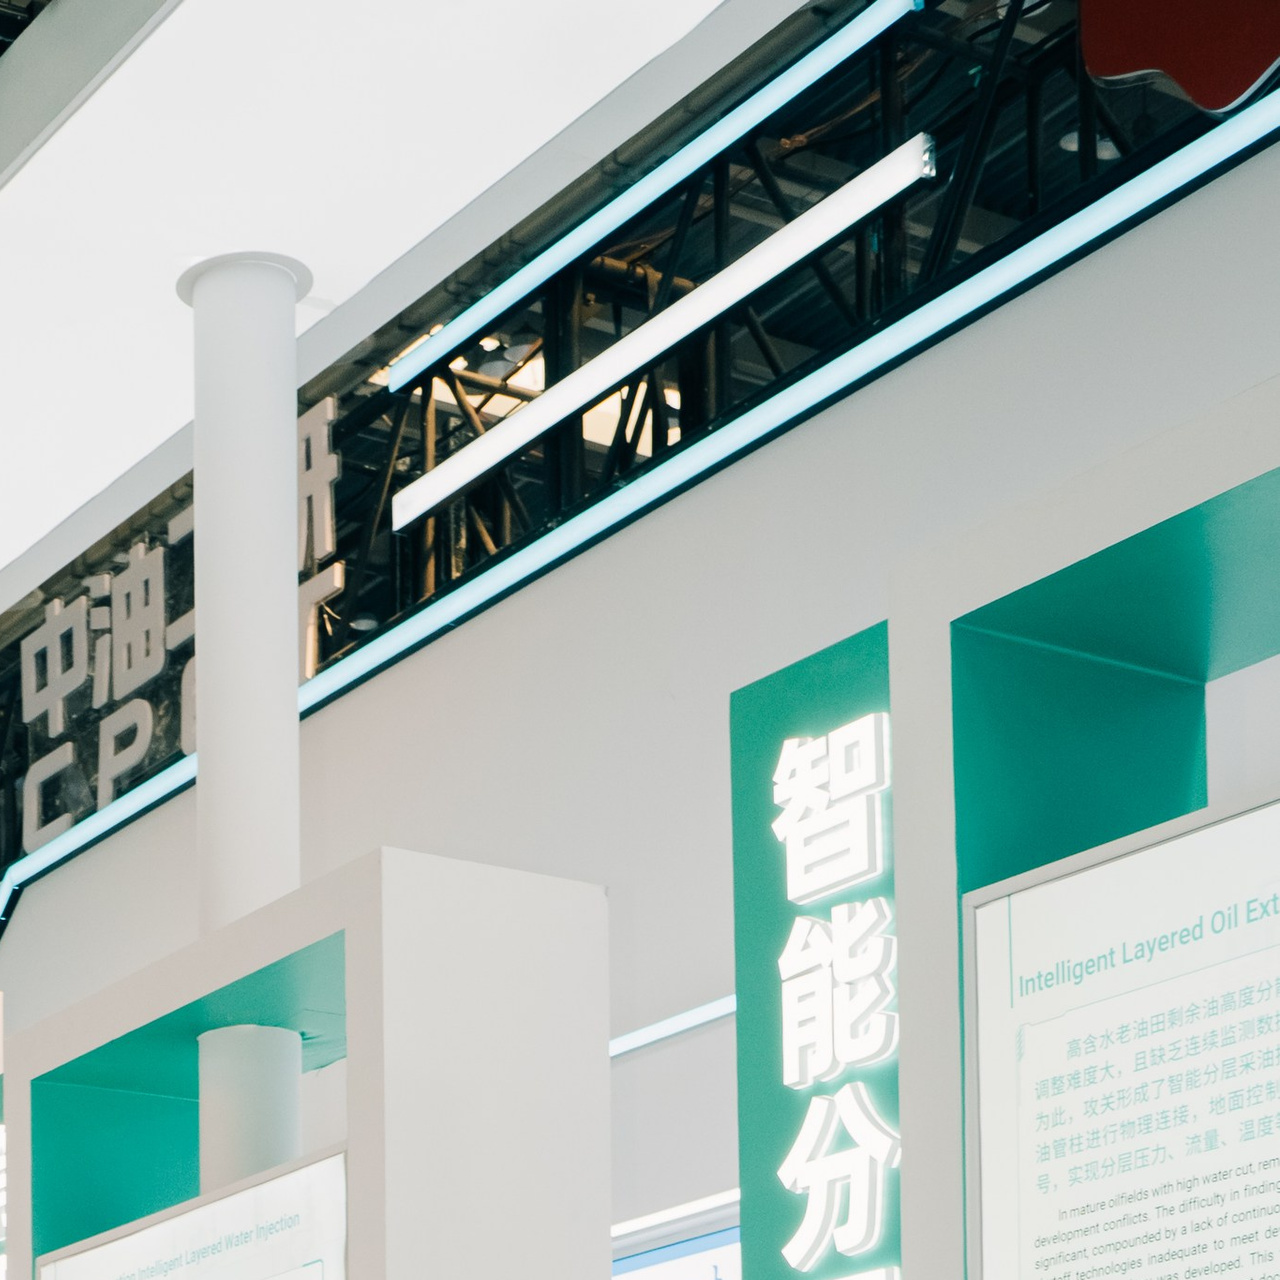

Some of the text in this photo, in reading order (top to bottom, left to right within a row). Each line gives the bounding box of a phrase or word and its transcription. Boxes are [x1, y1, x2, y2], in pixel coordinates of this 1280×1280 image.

[1018, 946, 1116, 997] Intelligent
[1121, 914, 1204, 964] Layered
[1209, 902, 1239, 934] Oil
[1033, 1222, 1100, 1248] development
[1102, 1211, 1151, 1232] conflicts.
[1154, 1204, 1176, 1218] The
[1178, 1191, 1226, 1214] difficulty
[1229, 1189, 1240, 1201] in
[1058, 1209, 1068, 1220] In
[1069, 1200, 1107, 1217] mature
[1107, 1187, 1149, 1208] oilfields
[1150, 1180, 1174, 1197] with
[1175, 1175, 1200, 1193] high
[1201, 1168, 1233, 1185] water
[1234, 1162, 1256, 1177] cut,
[185, 1237, 222, 1264] Layered
[224, 1229, 253, 1249] Water
[256, 1212, 300, 1241] Injection
[1034, 1247, 1089, 1271] significant,
[1091, 1227, 1162, 1256] compounded
[1163, 1226, 1178, 1241] by
[1180, 1224, 1188, 1236] a
[1190, 1216, 1214, 1232] lack
[1216, 1211, 1229, 1227] of
[1147, 1242, 1208, 1265] inadequate
[1212, 1238, 1225, 1250] to
[1230, 1229, 1259, 1246] meet
[1183, 1255, 1243, 1280] developed.
[1248, 1250, 1274, 1265] This
